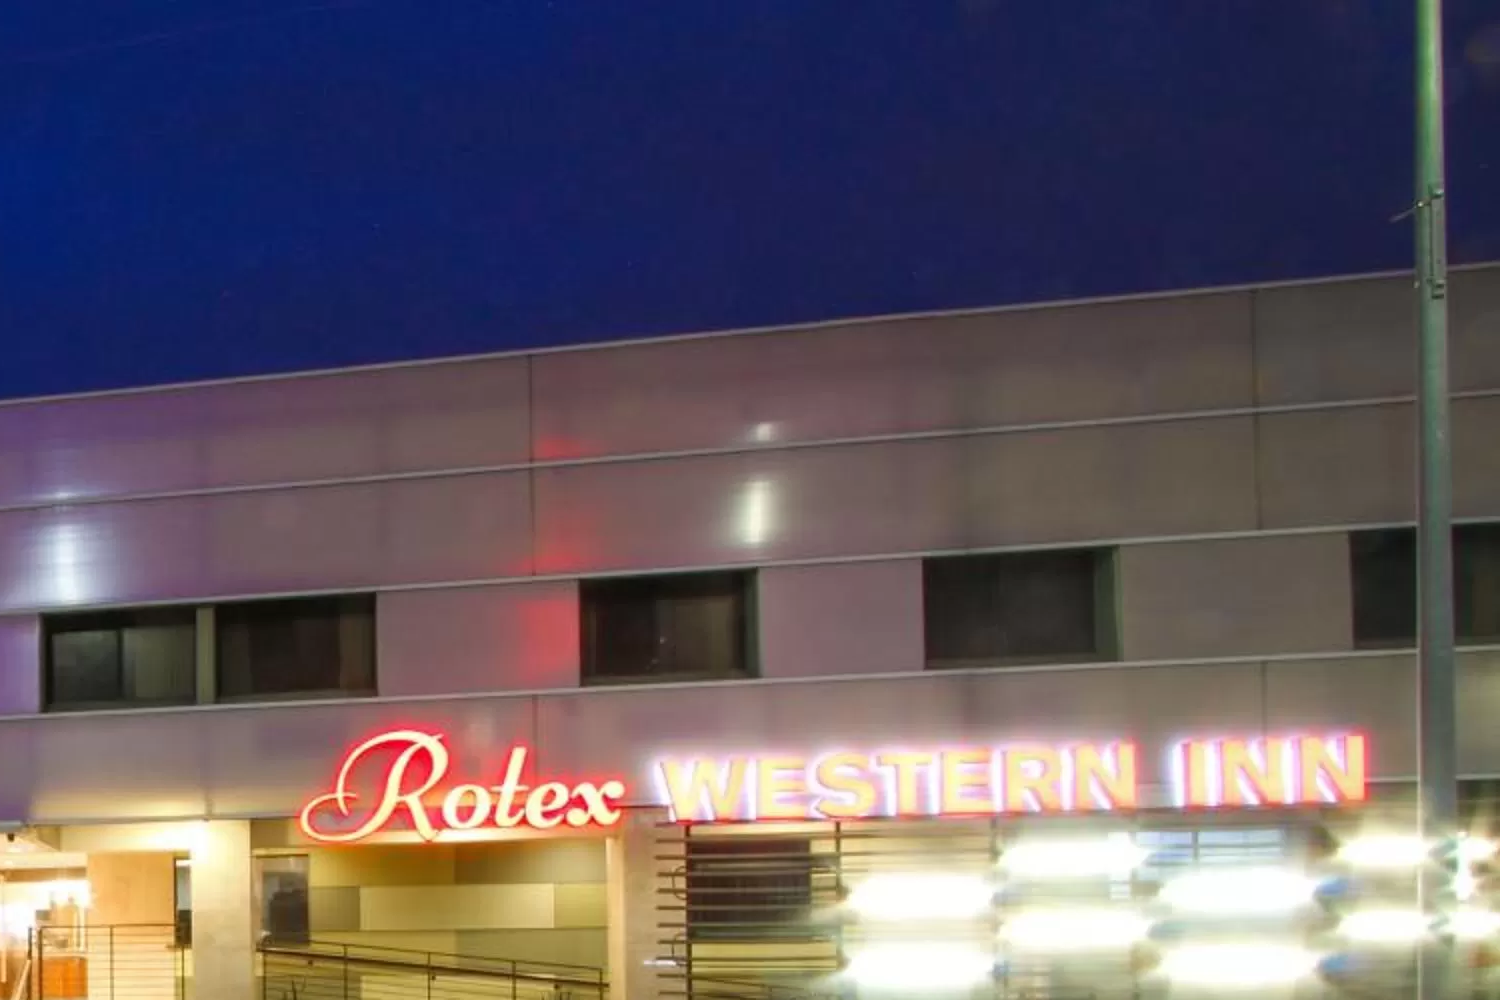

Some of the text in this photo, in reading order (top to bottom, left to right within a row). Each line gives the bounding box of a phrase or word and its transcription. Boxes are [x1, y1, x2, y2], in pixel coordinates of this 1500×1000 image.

[300, 729, 626, 842] Rotex
[655, 734, 1369, 823] WESTERN INN
